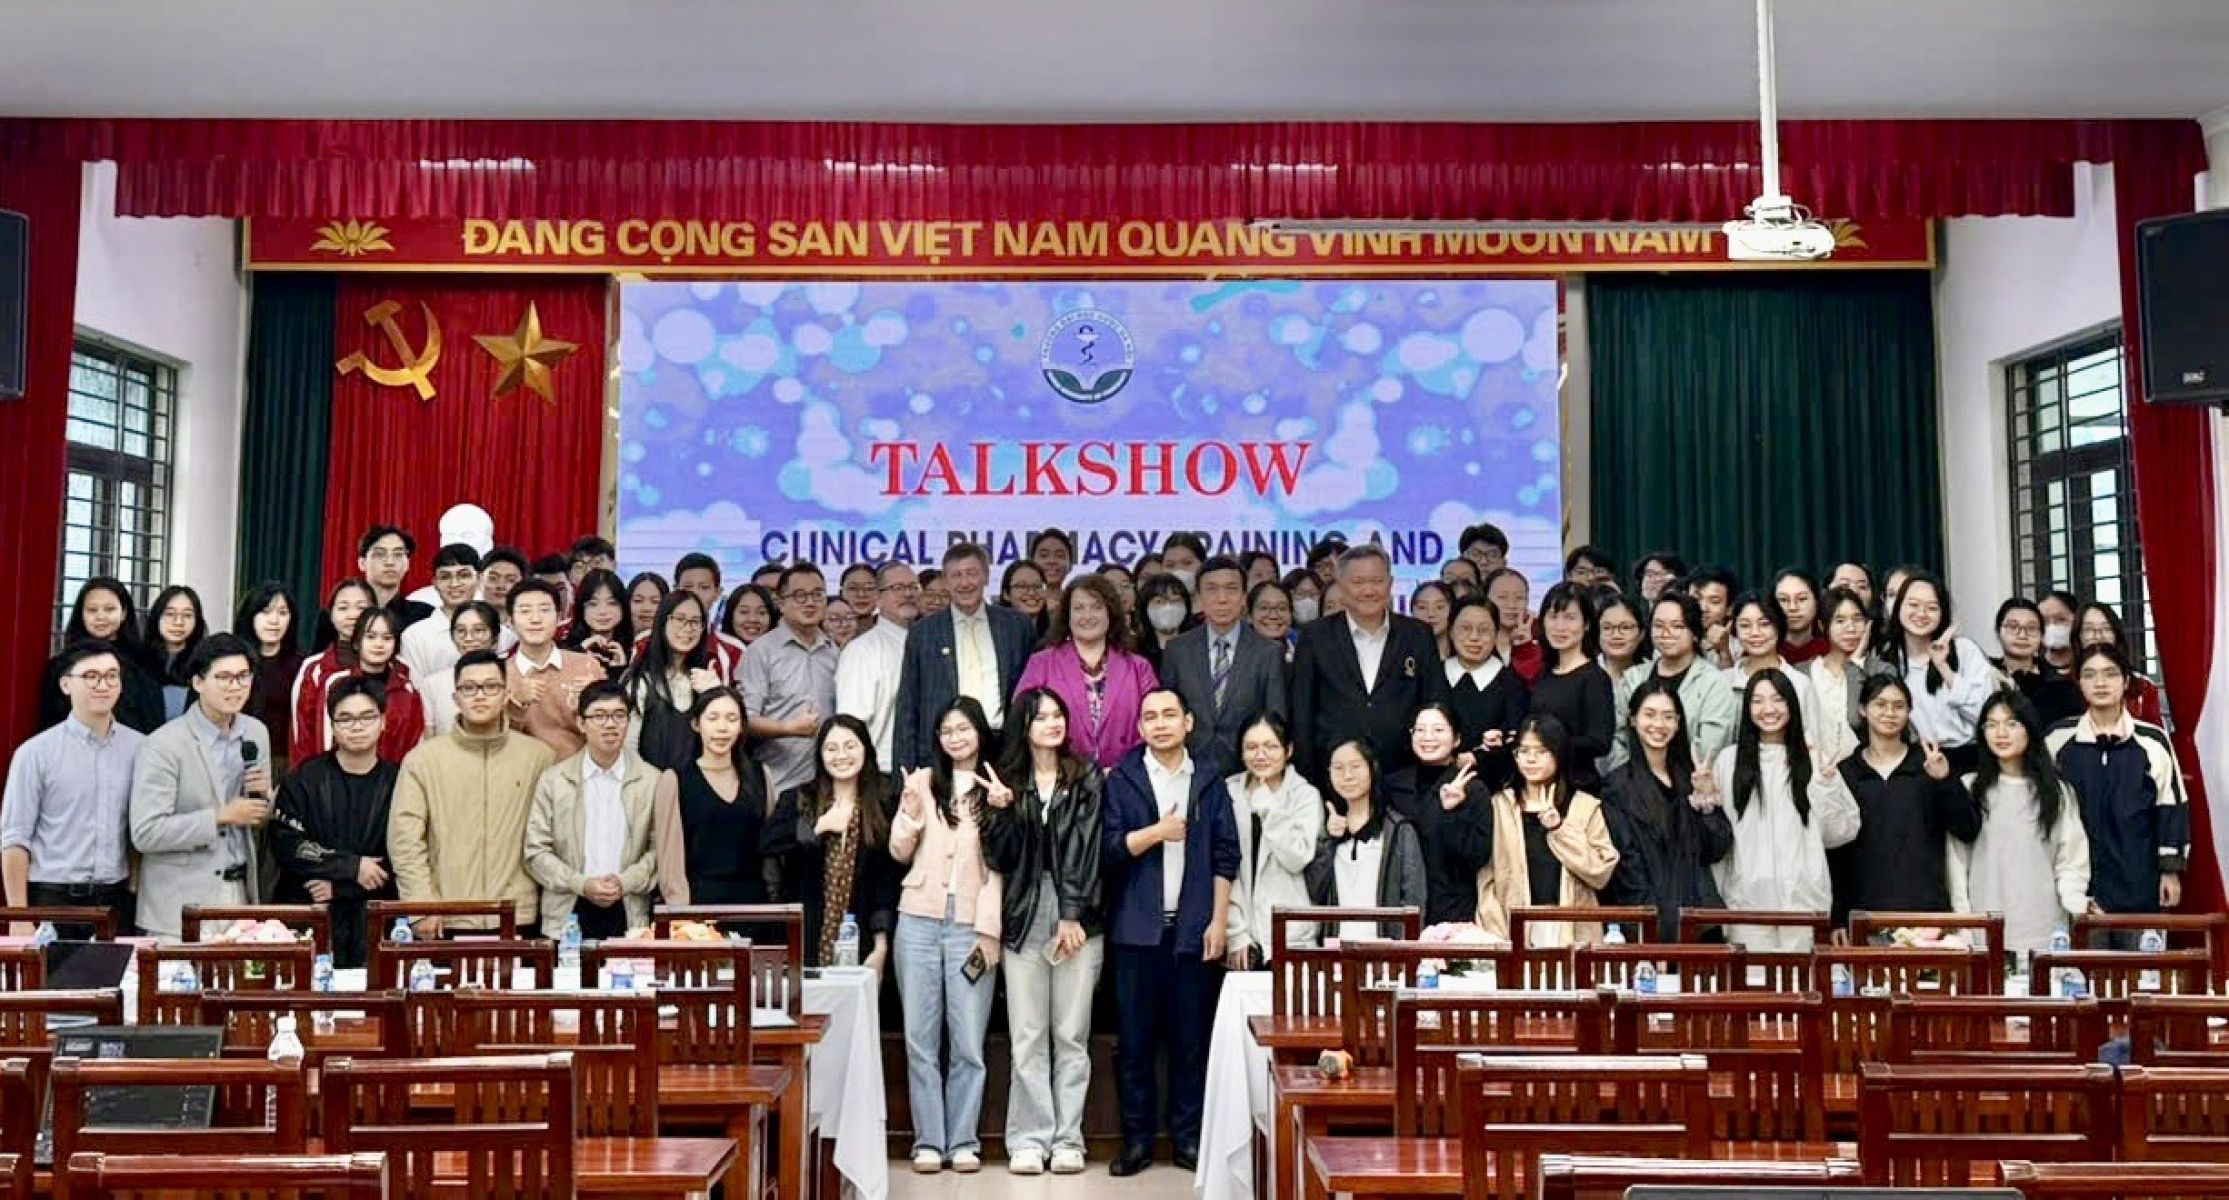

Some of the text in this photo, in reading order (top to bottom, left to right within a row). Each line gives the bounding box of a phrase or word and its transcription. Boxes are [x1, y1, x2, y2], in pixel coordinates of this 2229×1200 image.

[994, 220, 1108, 256] NAM
[1118, 220, 1297, 257] QUANG
[870, 442, 1311, 496] TALKSHOW
[761, 530, 934, 565] CLINICAL
[947, 530, 1160, 565] PHAACY
[1172, 530, 1348, 565] AININ
